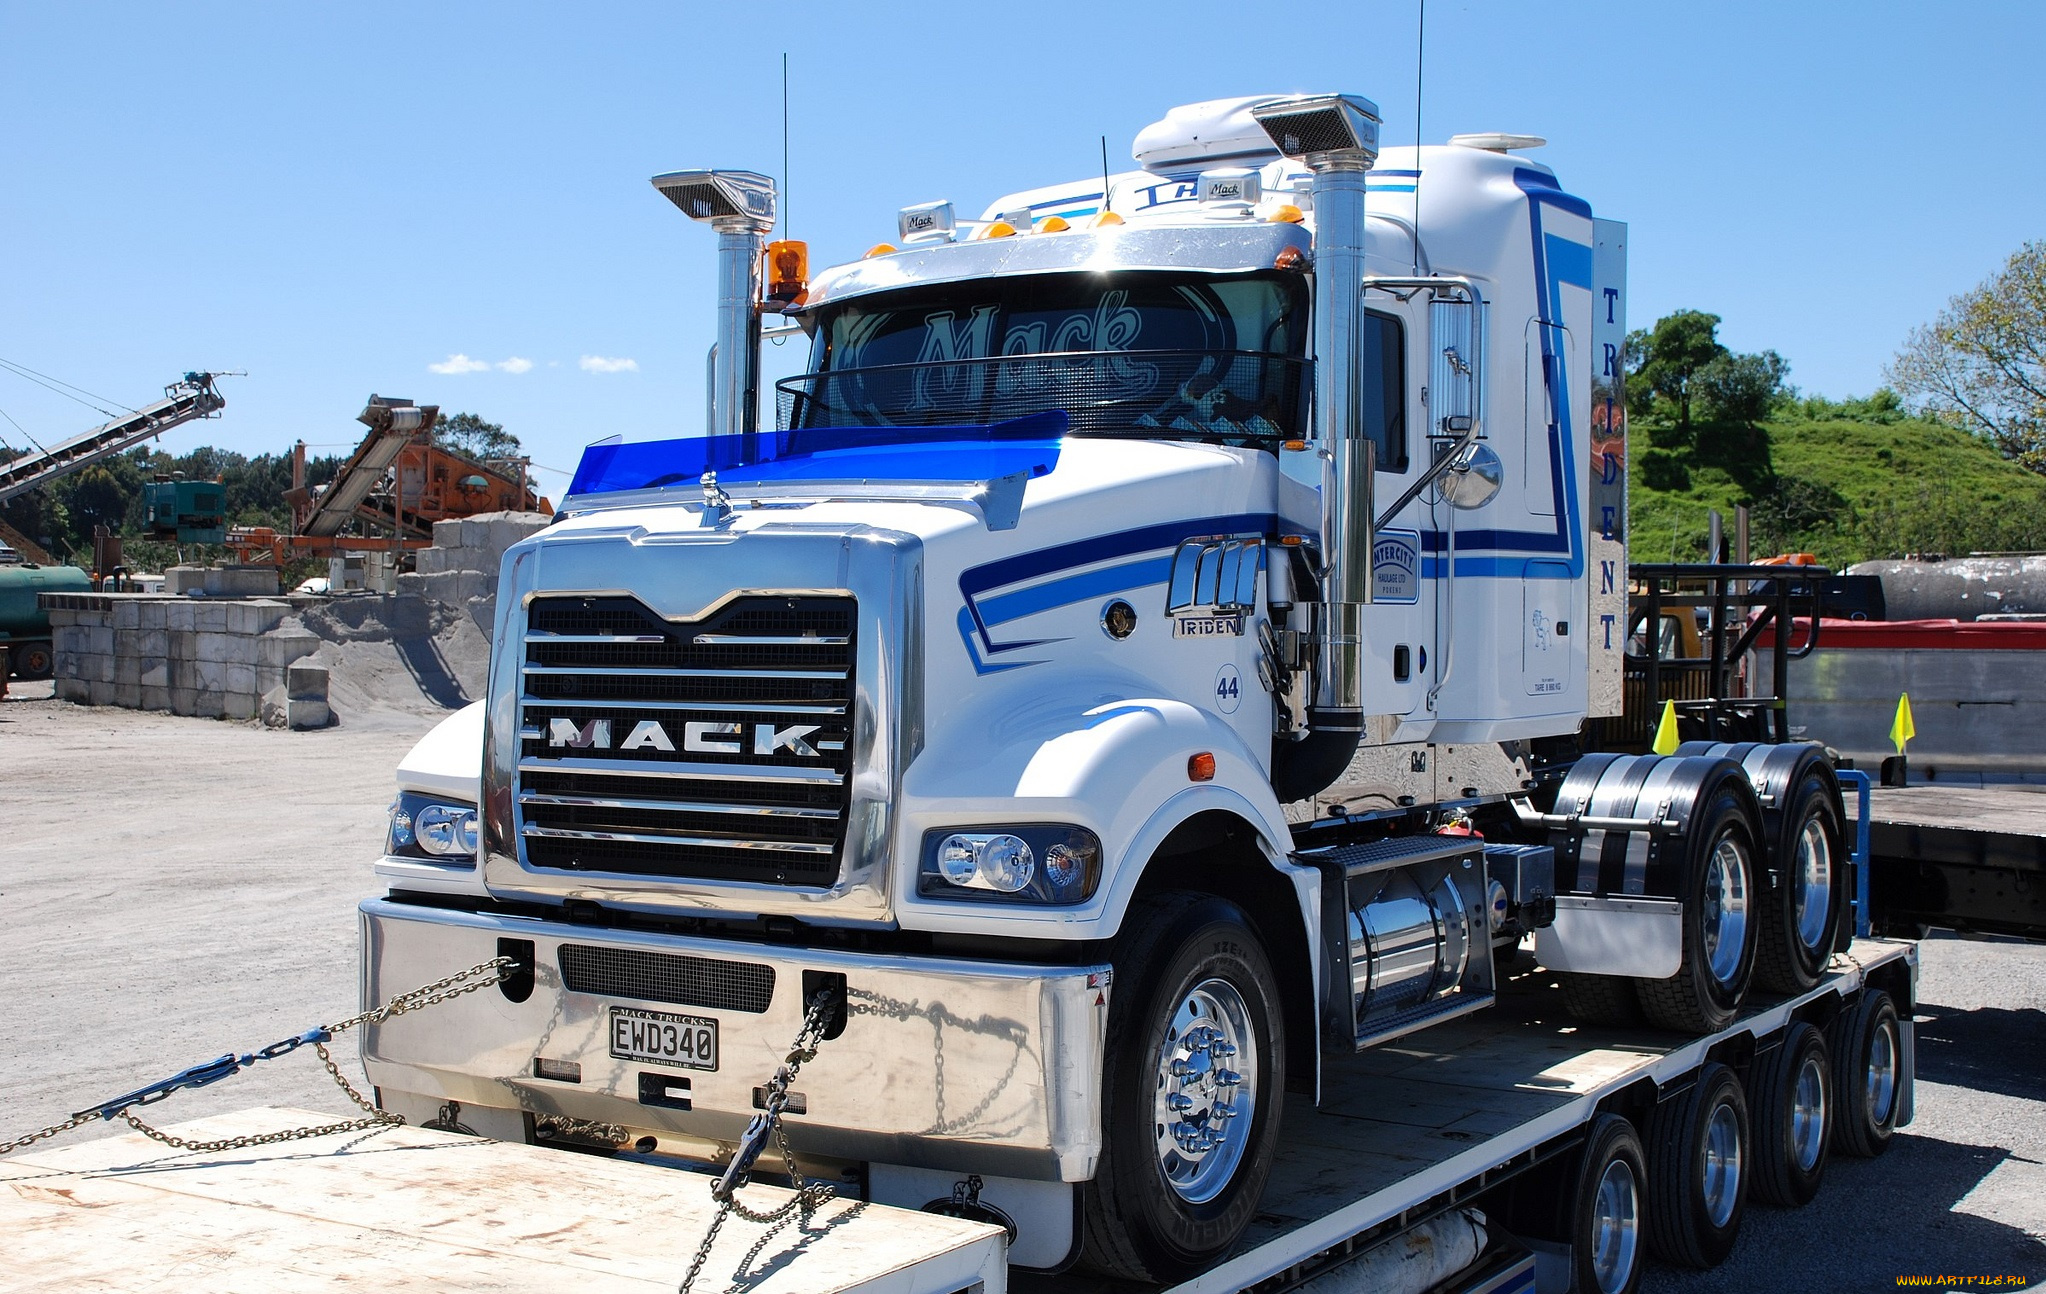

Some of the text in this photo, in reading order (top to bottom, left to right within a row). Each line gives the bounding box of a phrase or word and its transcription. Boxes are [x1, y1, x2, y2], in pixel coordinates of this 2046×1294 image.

[1210, 183, 1239, 197] Mack
[909, 214, 933, 229] Mack
[905, 290, 1160, 410] Mack
[1600, 288, 1618, 650] TRIDENT
[1374, 546, 1414, 568] NTERCITY
[1378, 573, 1397, 583] HAULAGE
[1178, 615, 1244, 635] TRIDENT
[1217, 677, 1239, 699] 44
[549, 717, 822, 757] MACK
[620, 1008, 707, 1026] MACK TRUCKS
[615, 1018, 712, 1061] EWD340
